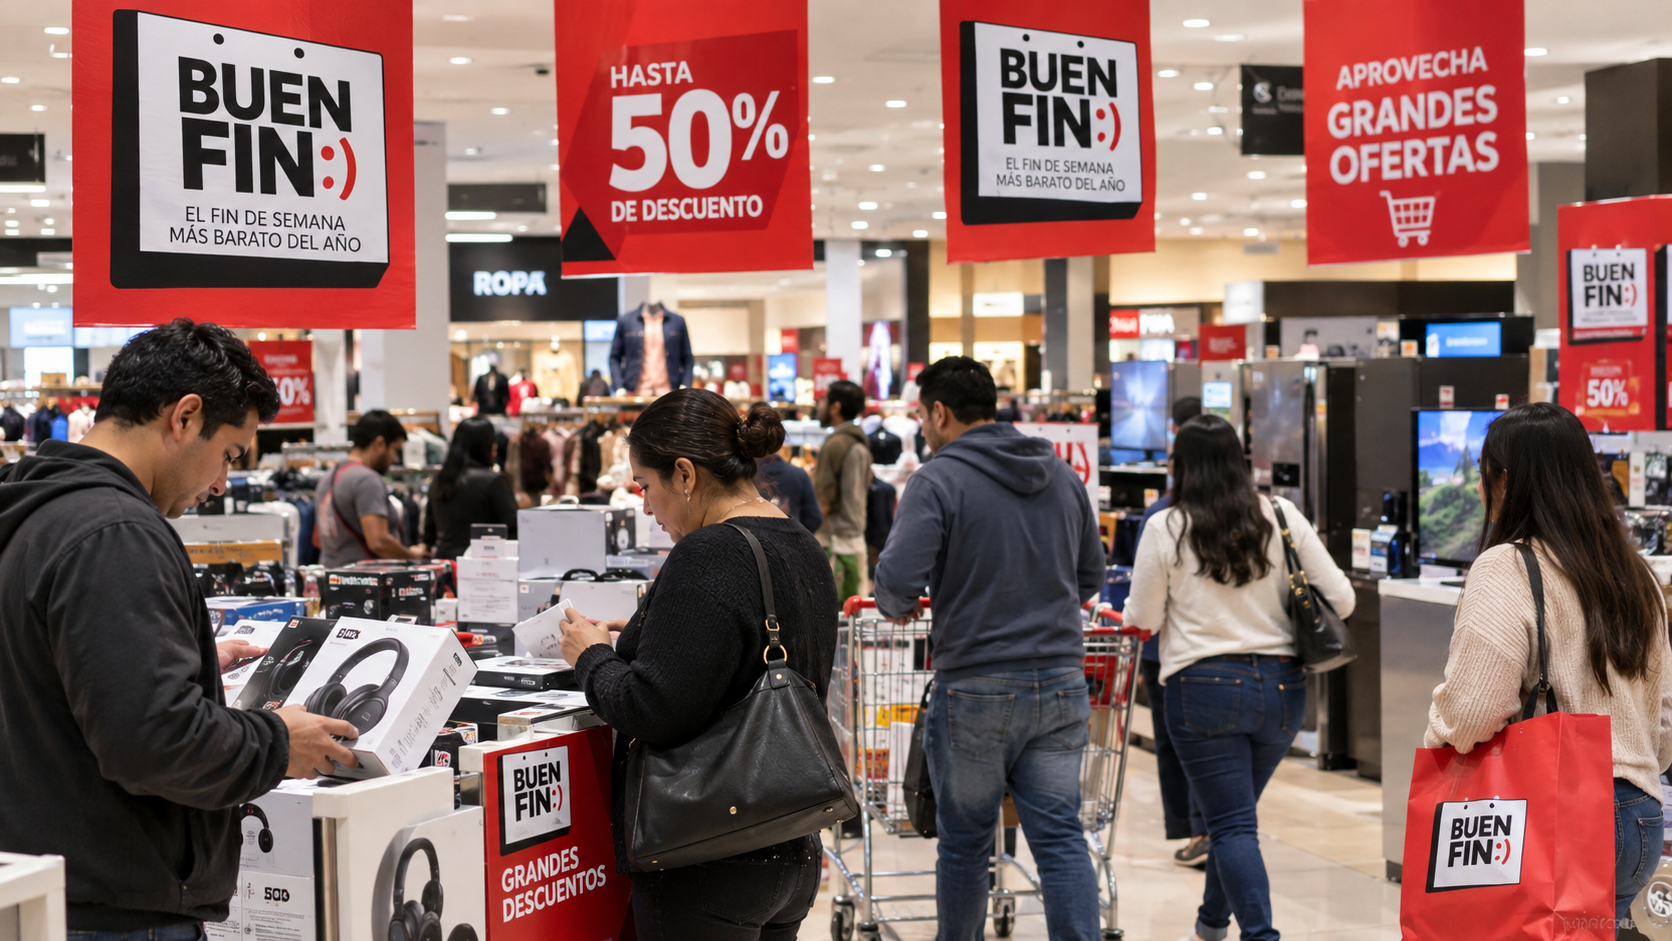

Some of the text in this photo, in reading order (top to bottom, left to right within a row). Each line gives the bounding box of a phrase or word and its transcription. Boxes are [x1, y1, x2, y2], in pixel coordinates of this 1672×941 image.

[610, 61, 693, 89] HASTA
[1000, 47, 1118, 98] BUEN
[1336, 46, 1488, 91] APROVECHA
[178, 56, 352, 133] BUEN
[1327, 84, 1498, 139] GRANDES
[608, 88, 789, 192] 50%
[1006, 157, 1114, 175] EL FIN DE SEMANA
[1329, 130, 1500, 185] OFERTAS
[996, 171, 1125, 192] MÁS BARATO DEL AÑO
[185, 206, 346, 231] EL FIN DE SEMANA
[611, 194, 763, 222] DE DESCUENTO
[170, 224, 361, 252] MÁS BARATO DEL AÑO
[473, 270, 547, 296] ROPA
[1583, 263, 1635, 283] BUEN
[1586, 378, 1629, 408] 50%
[513, 760, 561, 792] BUEN
[1450, 814, 1513, 840] BUEN
[501, 846, 579, 893] GRANDES
[502, 864, 607, 923] DESCUENTOS
